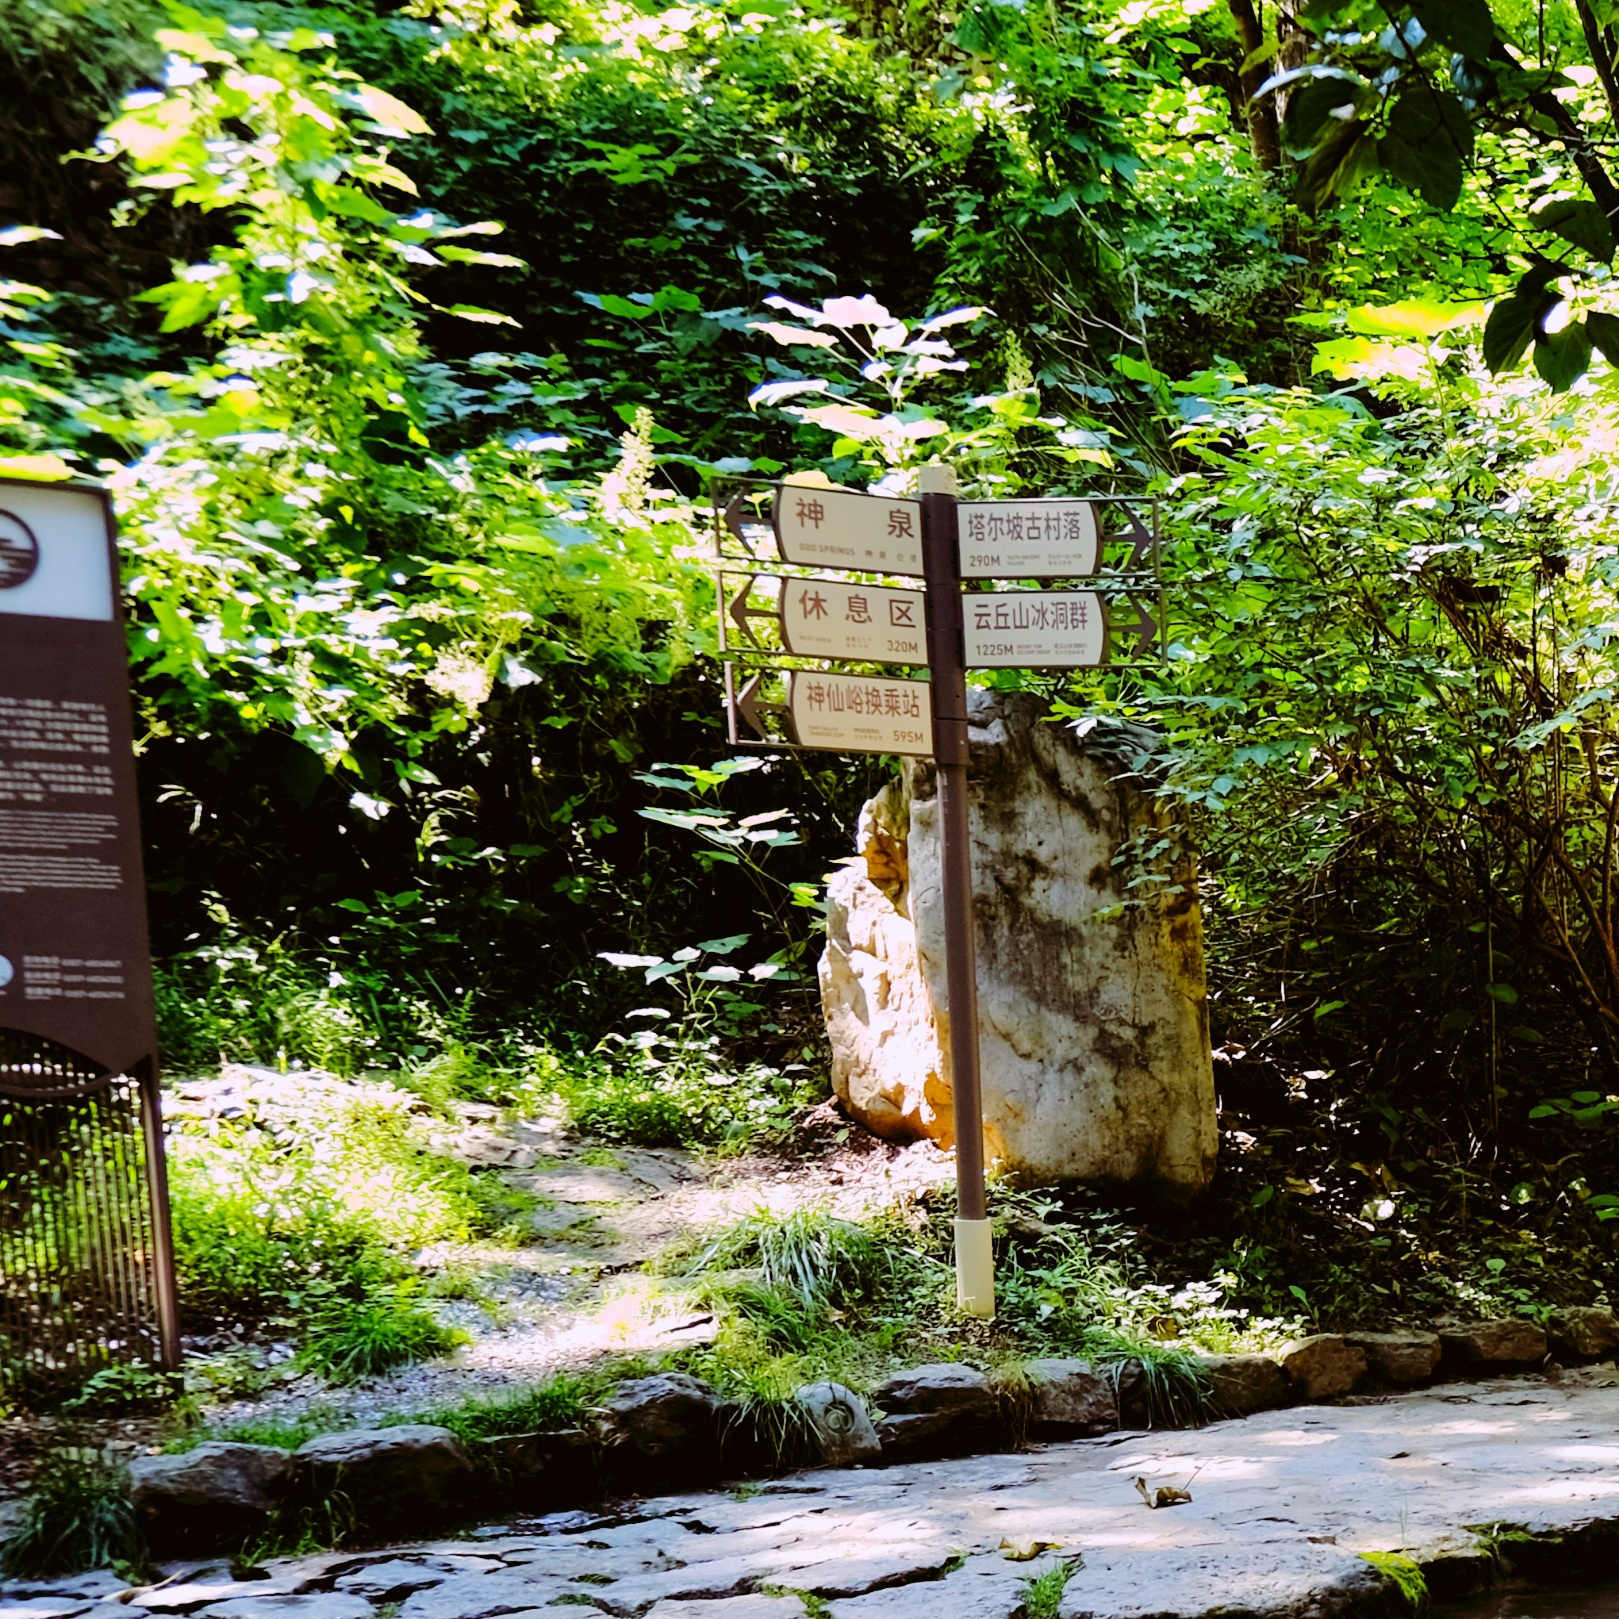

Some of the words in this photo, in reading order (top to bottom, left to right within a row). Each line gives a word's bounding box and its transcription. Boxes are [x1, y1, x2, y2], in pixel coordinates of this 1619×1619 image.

[795, 497, 915, 539] 神泉
[967, 510, 1081, 542] 塔尔坡古村落
[969, 553, 1001, 567] 290M
[799, 589, 917, 628] 休息区
[974, 600, 1088, 631] 云丘山冰洞群
[887, 639, 919, 653] 320M
[976, 643, 1014, 656] 1225M
[806, 681, 921, 718] 神仙峪换乘站
[892, 729, 924, 744] 595M
